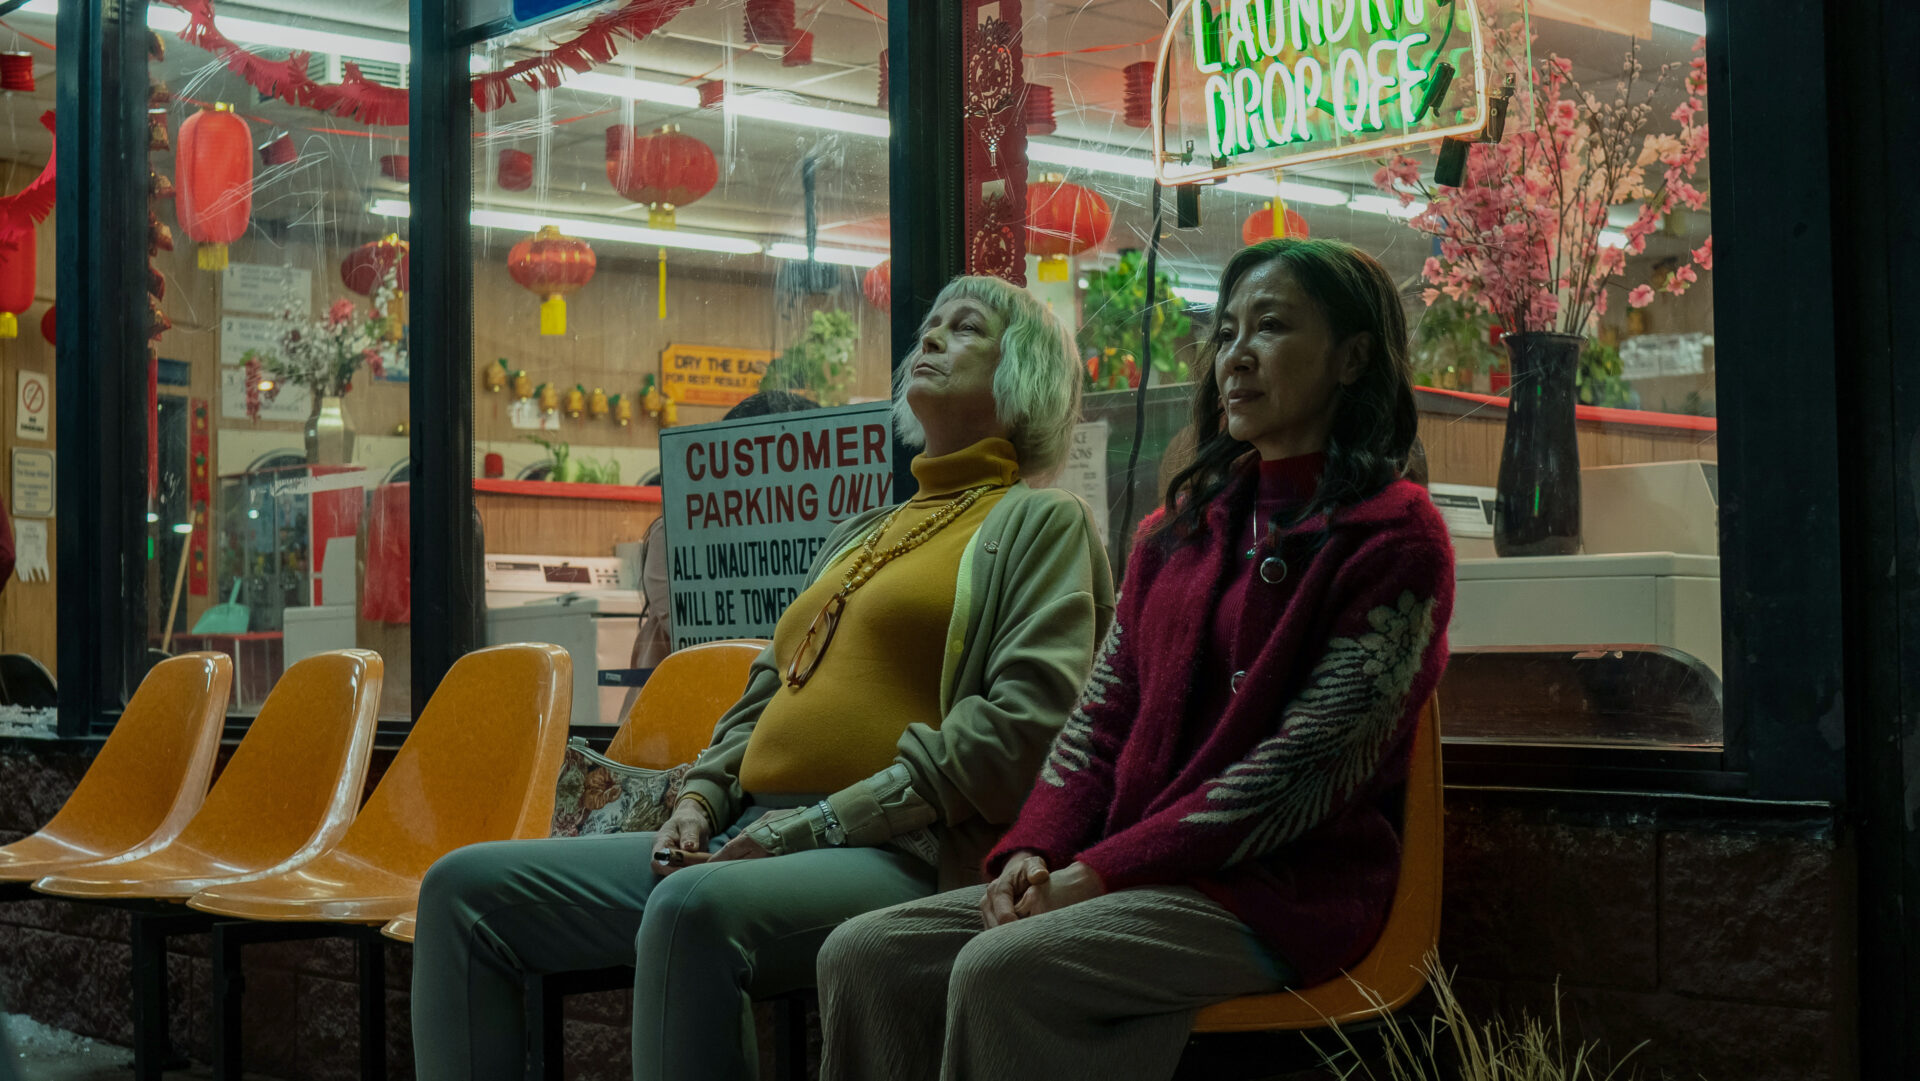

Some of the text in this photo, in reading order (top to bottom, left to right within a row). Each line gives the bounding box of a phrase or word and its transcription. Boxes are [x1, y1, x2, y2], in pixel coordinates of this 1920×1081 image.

[1192, 0, 1425, 73] LAUND
[1204, 32, 1430, 158] DROP OFF
[665, 373, 685, 384] FOR
[688, 374, 711, 385] BEST
[674, 355, 702, 369] DRY
[707, 356, 732, 373] THE
[685, 423, 887, 482] CUSTOMER
[686, 471, 893, 530] PARKING ONLY
[673, 545, 703, 582] ALL
[674, 590, 713, 627] WILL
[715, 589, 737, 625] BE
